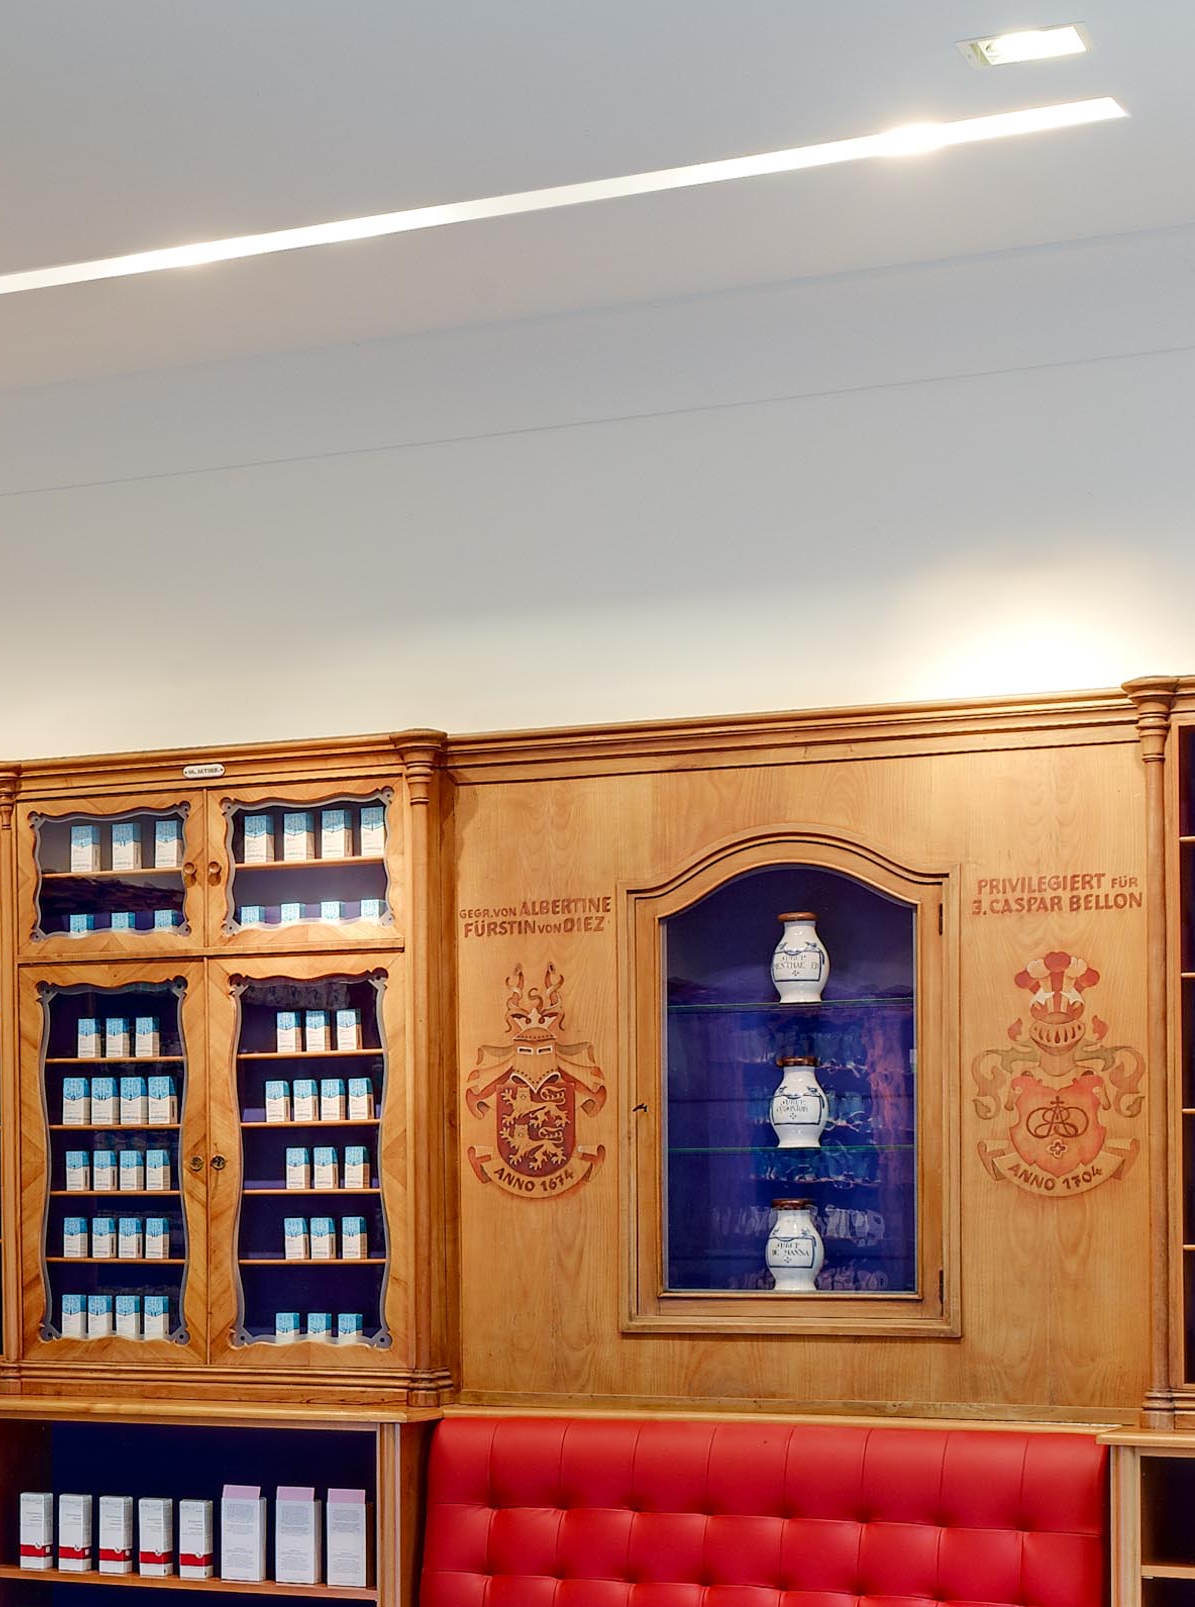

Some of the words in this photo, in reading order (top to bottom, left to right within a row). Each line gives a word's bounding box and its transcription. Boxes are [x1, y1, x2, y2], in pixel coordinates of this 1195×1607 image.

[977, 873, 1106, 896] PRIVILEGIERT
[1111, 875, 1139, 890] FÜR
[519, 896, 612, 917] ALBERTINE
[1069, 892, 1143, 913] BELLON
[464, 919, 536, 939] FÜRSTIN
[537, 923, 562, 934] VON
[563, 916, 606, 933] DIEZ
[494, 1167, 536, 1192] ANNO
[540, 1169, 574, 1191] 1674
[1008, 1163, 1056, 1191] ANNO
[1062, 1165, 1103, 1190] 1704
